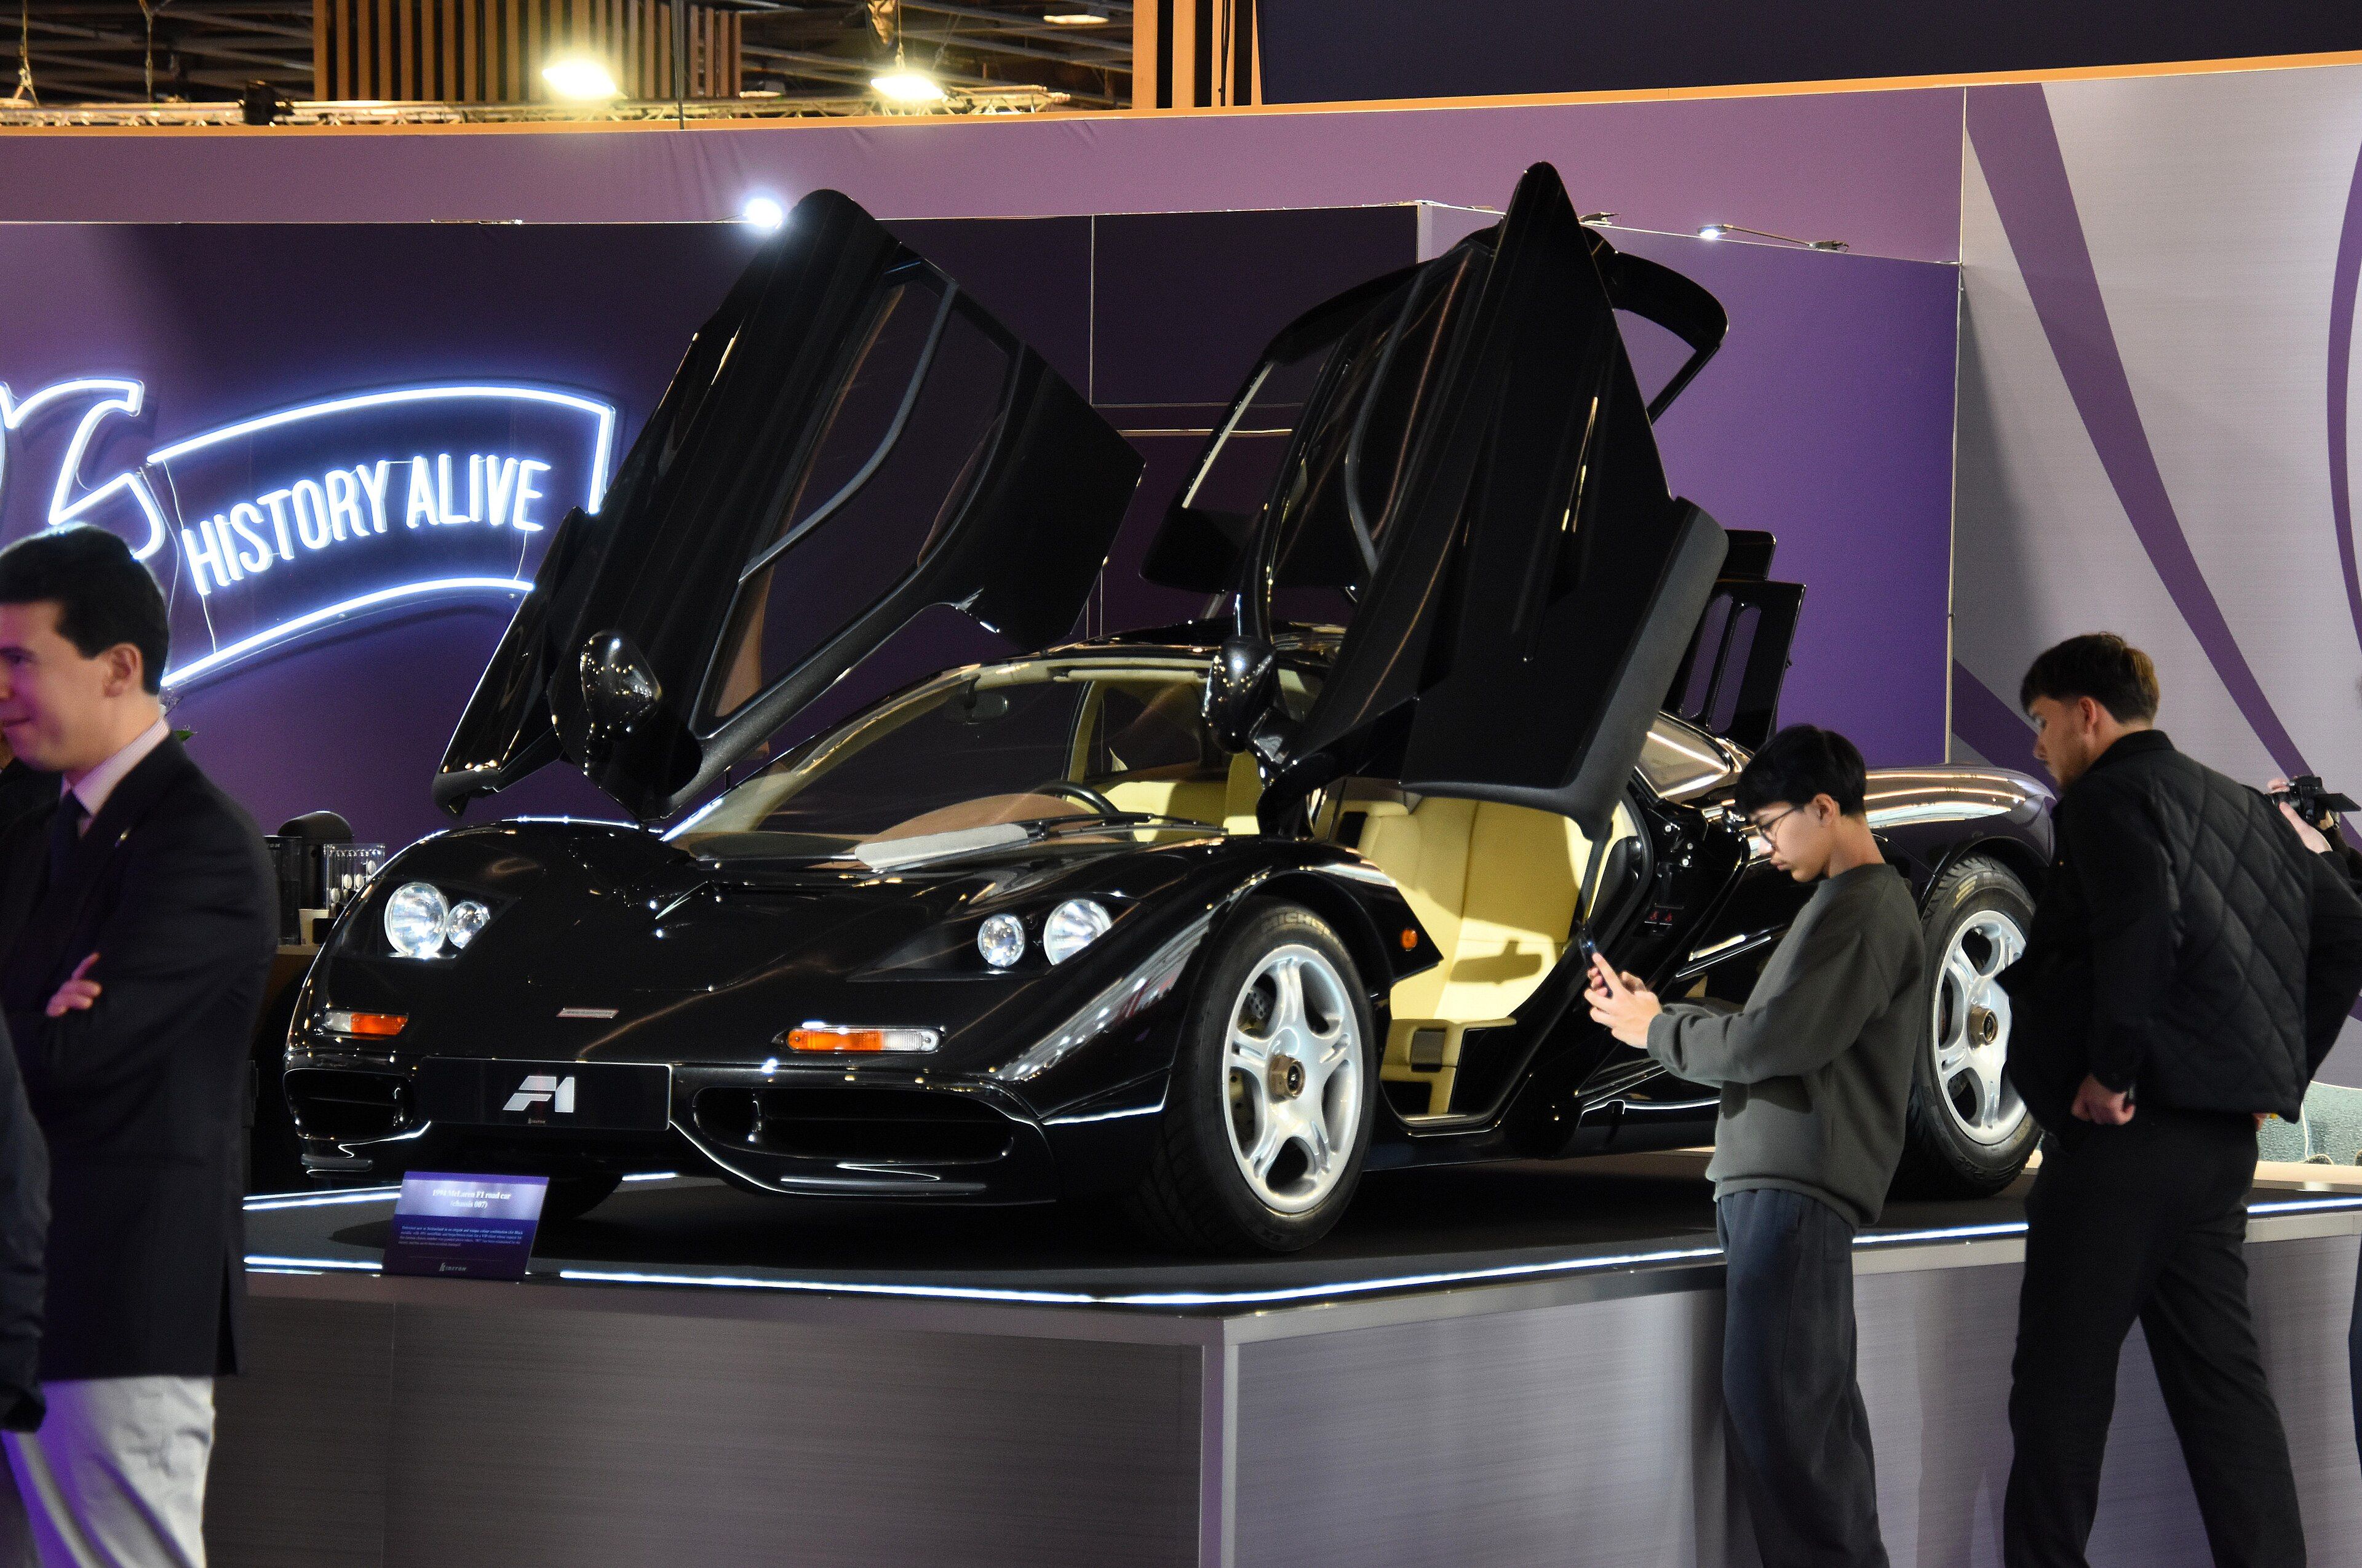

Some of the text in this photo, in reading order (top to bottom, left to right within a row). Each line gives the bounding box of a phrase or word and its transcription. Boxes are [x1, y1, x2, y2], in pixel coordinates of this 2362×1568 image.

[181, 453, 551, 595] HISTORY ALIVE
[503, 1075, 575, 1113] F1
